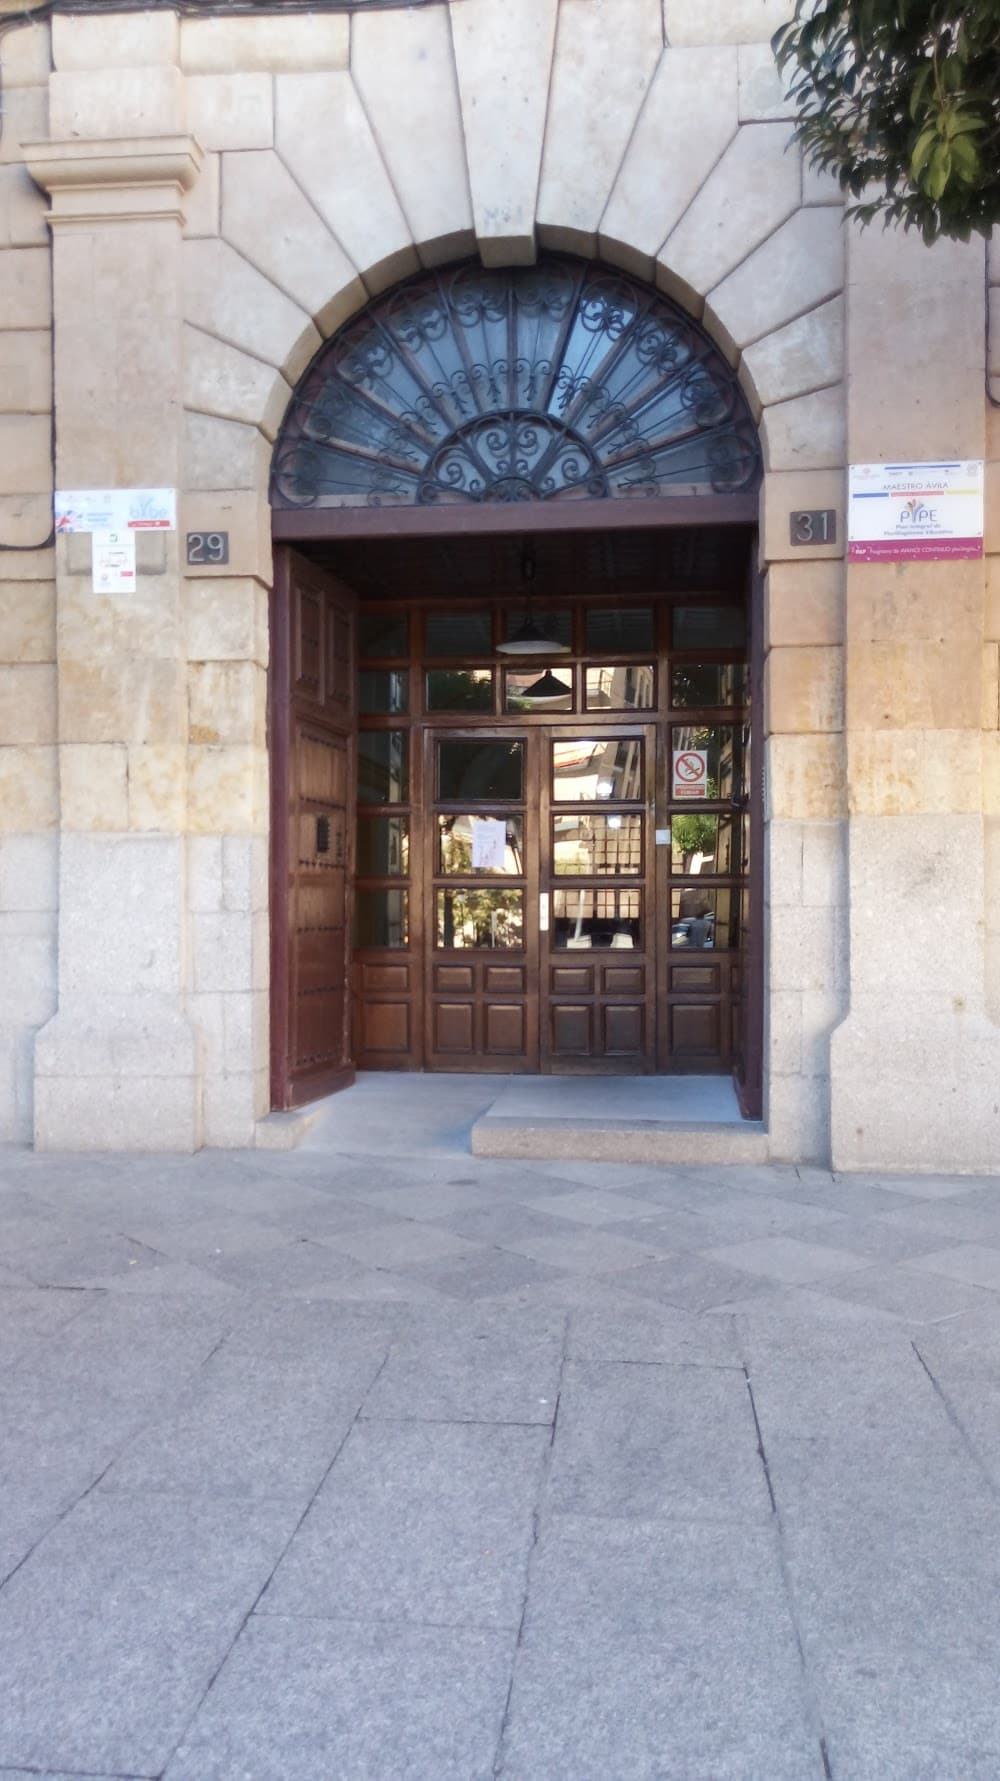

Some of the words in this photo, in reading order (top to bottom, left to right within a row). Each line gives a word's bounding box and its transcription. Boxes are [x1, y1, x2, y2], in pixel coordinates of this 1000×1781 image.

[883, 483, 923, 491] MAESTRO
[796, 511, 828, 542] 31
[188, 533, 224, 562] 29
